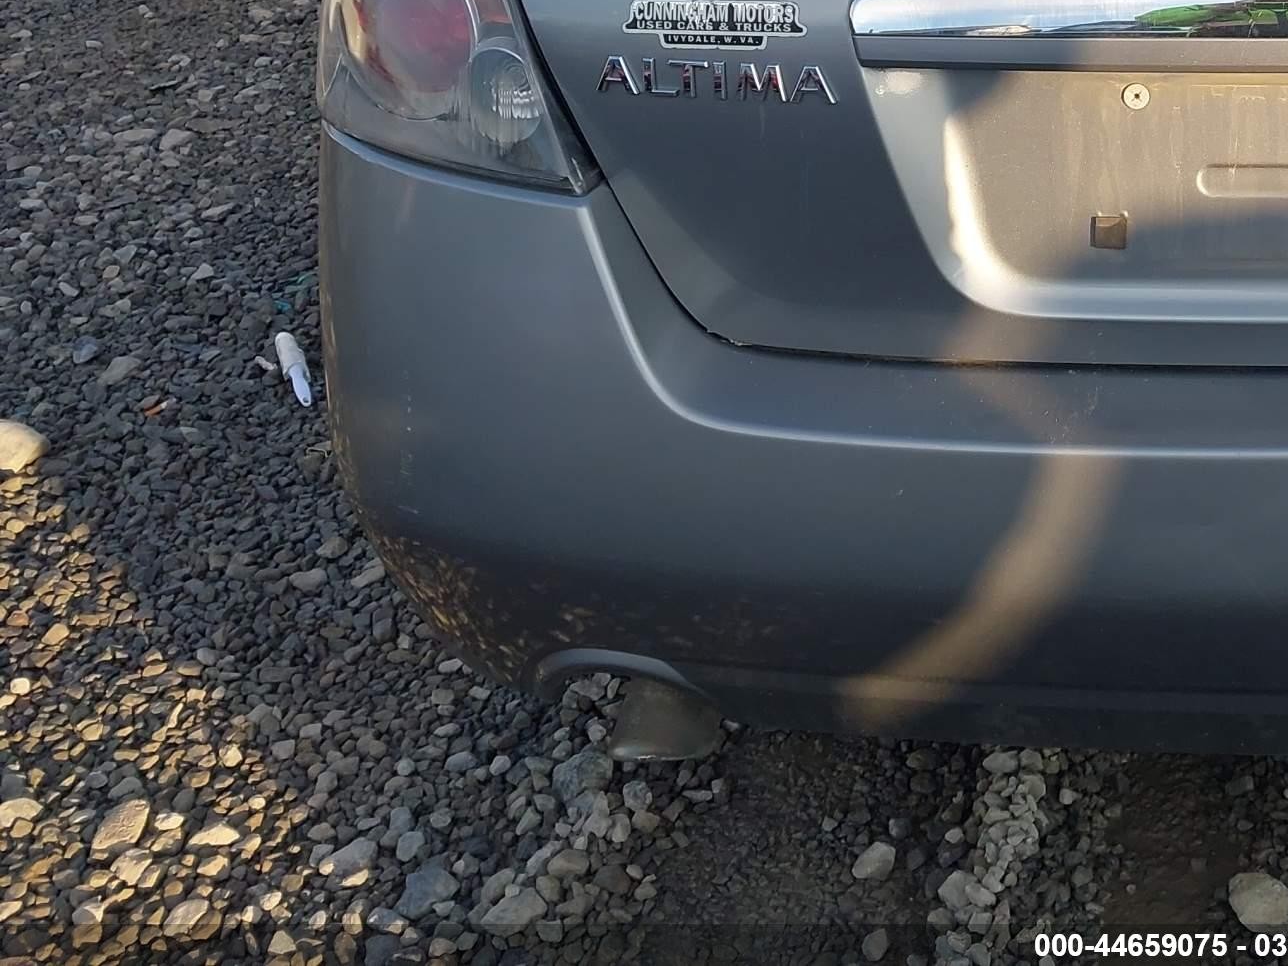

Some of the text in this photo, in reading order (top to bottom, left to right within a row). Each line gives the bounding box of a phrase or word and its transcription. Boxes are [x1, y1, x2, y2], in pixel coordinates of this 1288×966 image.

[634, 1, 794, 23] CUNNINGHAM MOTORS
[637, 20, 792, 32] USED CARS & TRUCKS
[668, 35, 721, 44] IVYDALE,
[595, 54, 839, 106] ALTIMA
